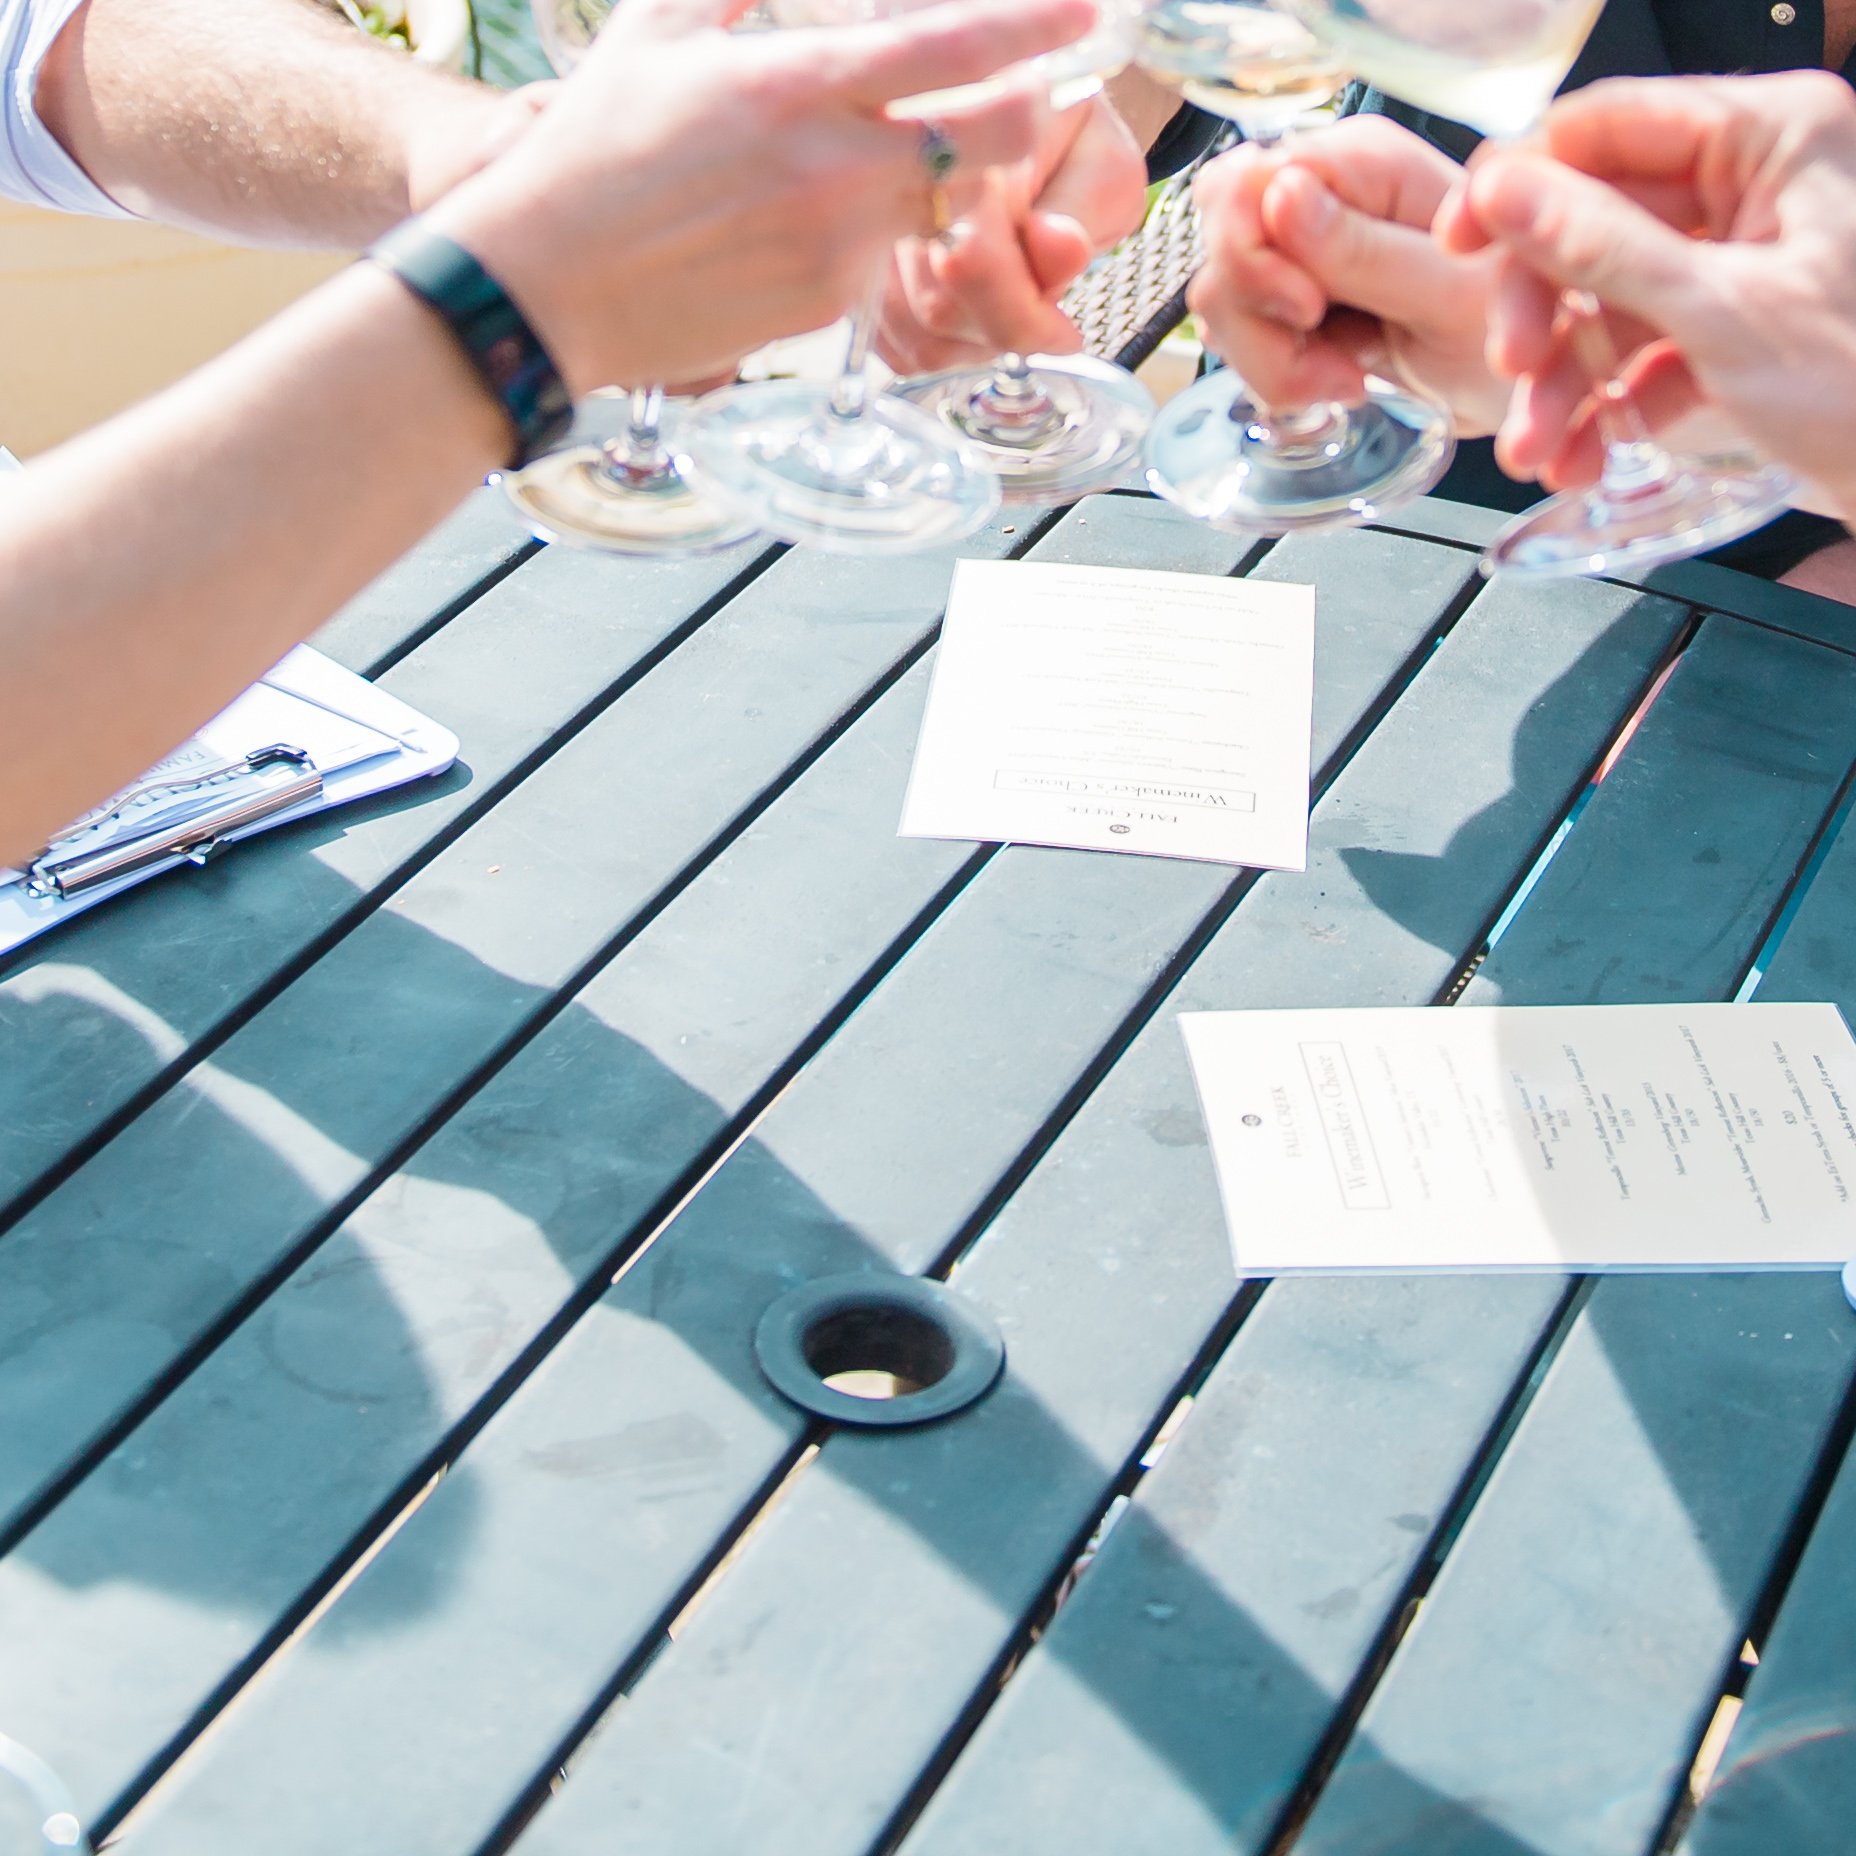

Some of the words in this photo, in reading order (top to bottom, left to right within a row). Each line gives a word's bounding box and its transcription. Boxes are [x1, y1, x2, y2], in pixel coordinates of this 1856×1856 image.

[1016, 775, 1089, 793] Choice
[1094, 782, 1227, 806] Winemaker's
[1317, 1055, 1343, 1097] Choice
[1326, 1101, 1367, 1189] Winemaker's
